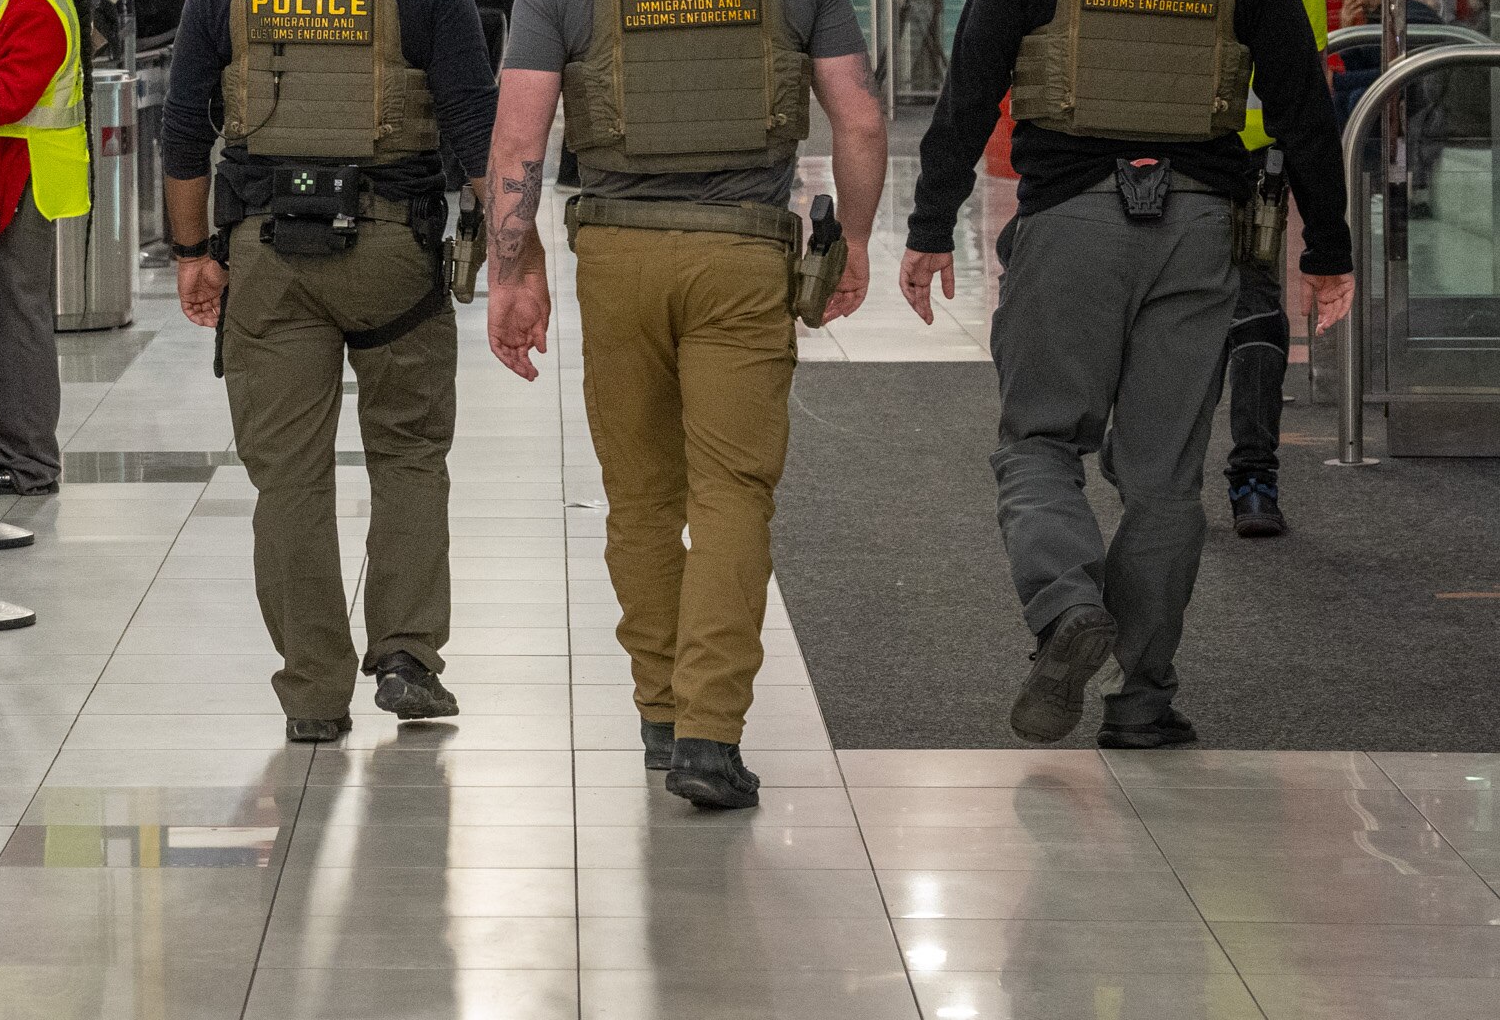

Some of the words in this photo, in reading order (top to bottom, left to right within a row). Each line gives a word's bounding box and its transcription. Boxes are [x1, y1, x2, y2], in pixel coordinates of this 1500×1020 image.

[260, 17, 329, 28] IMMIGRATION
[333, 18, 355, 28] AND
[626, 13, 676, 26] CUSTOMS
[680, 9, 757, 24] ENFORCEMENT
[250, 28, 294, 40] CUSTOMS
[298, 29, 369, 41] ENFORCEMENT
